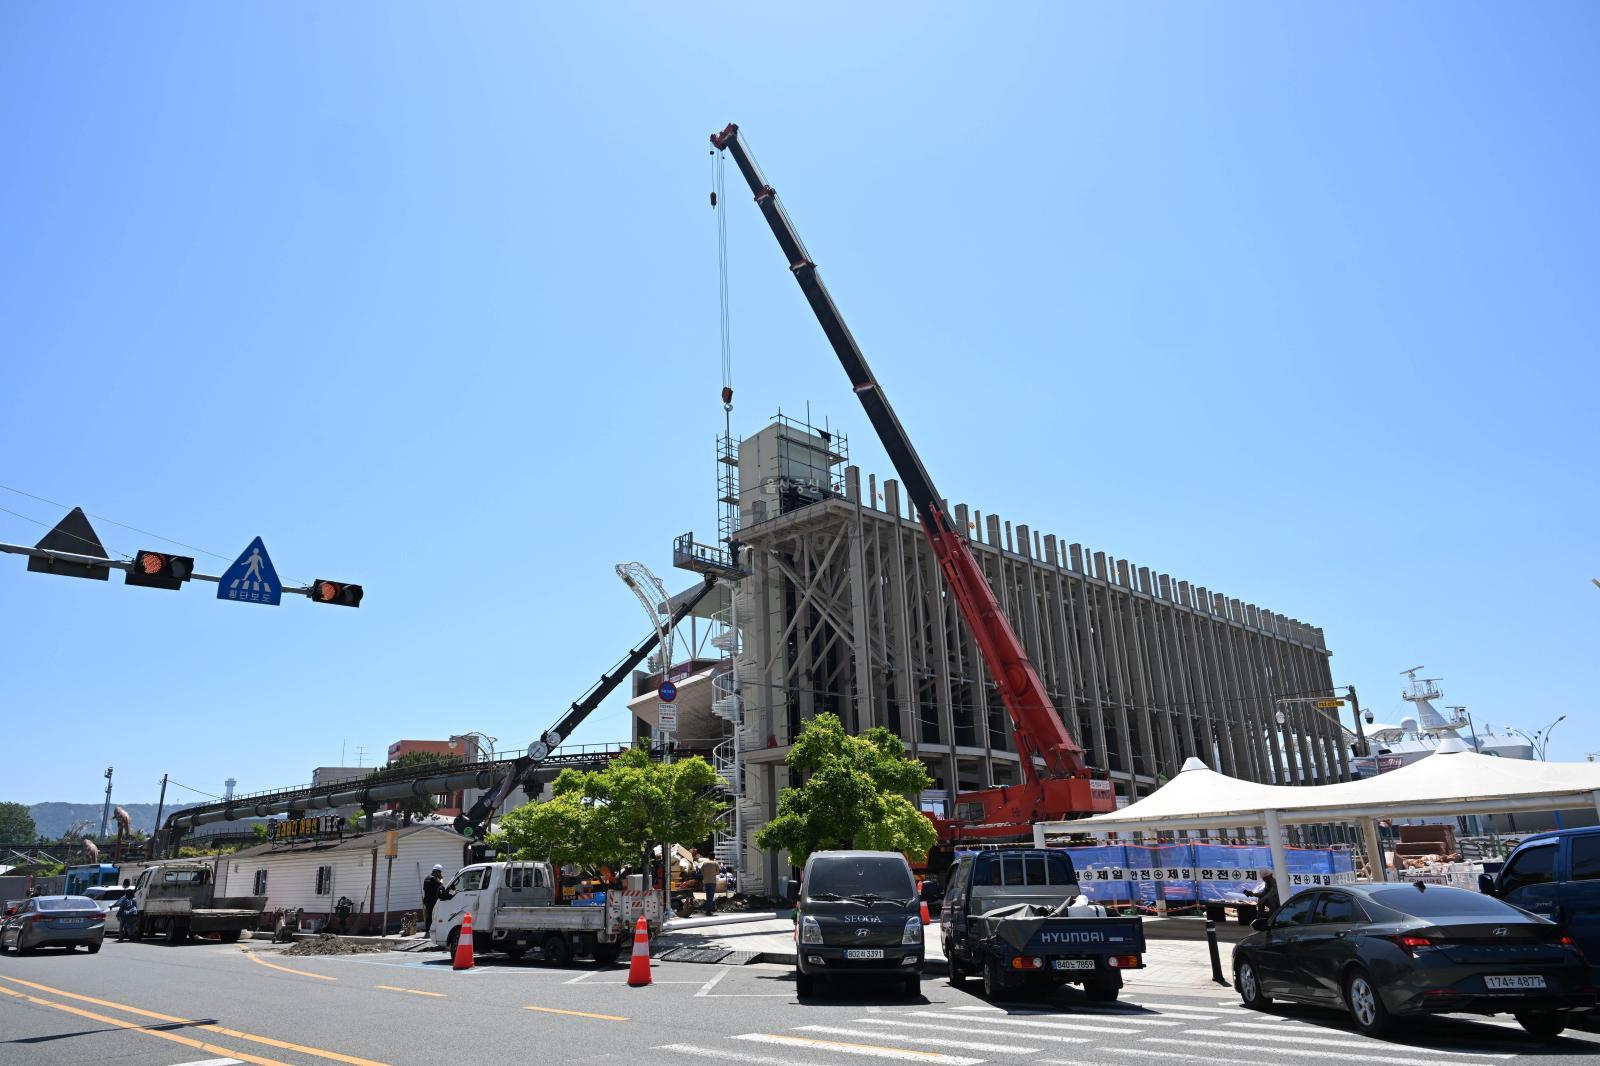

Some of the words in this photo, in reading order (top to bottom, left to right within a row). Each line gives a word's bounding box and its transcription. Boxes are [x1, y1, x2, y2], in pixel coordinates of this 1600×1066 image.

[228, 589, 271, 602] 횡단보도
[1097, 870, 1123, 880] 제일
[1130, 870, 1151, 880] 안전
[1167, 869, 1190, 880] 제일
[1201, 869, 1229, 880] 안전
[1312, 875, 1331, 886] 제일
[844, 914, 881, 923] SEOGA
[1041, 932, 1104, 943] HYUNDAI
